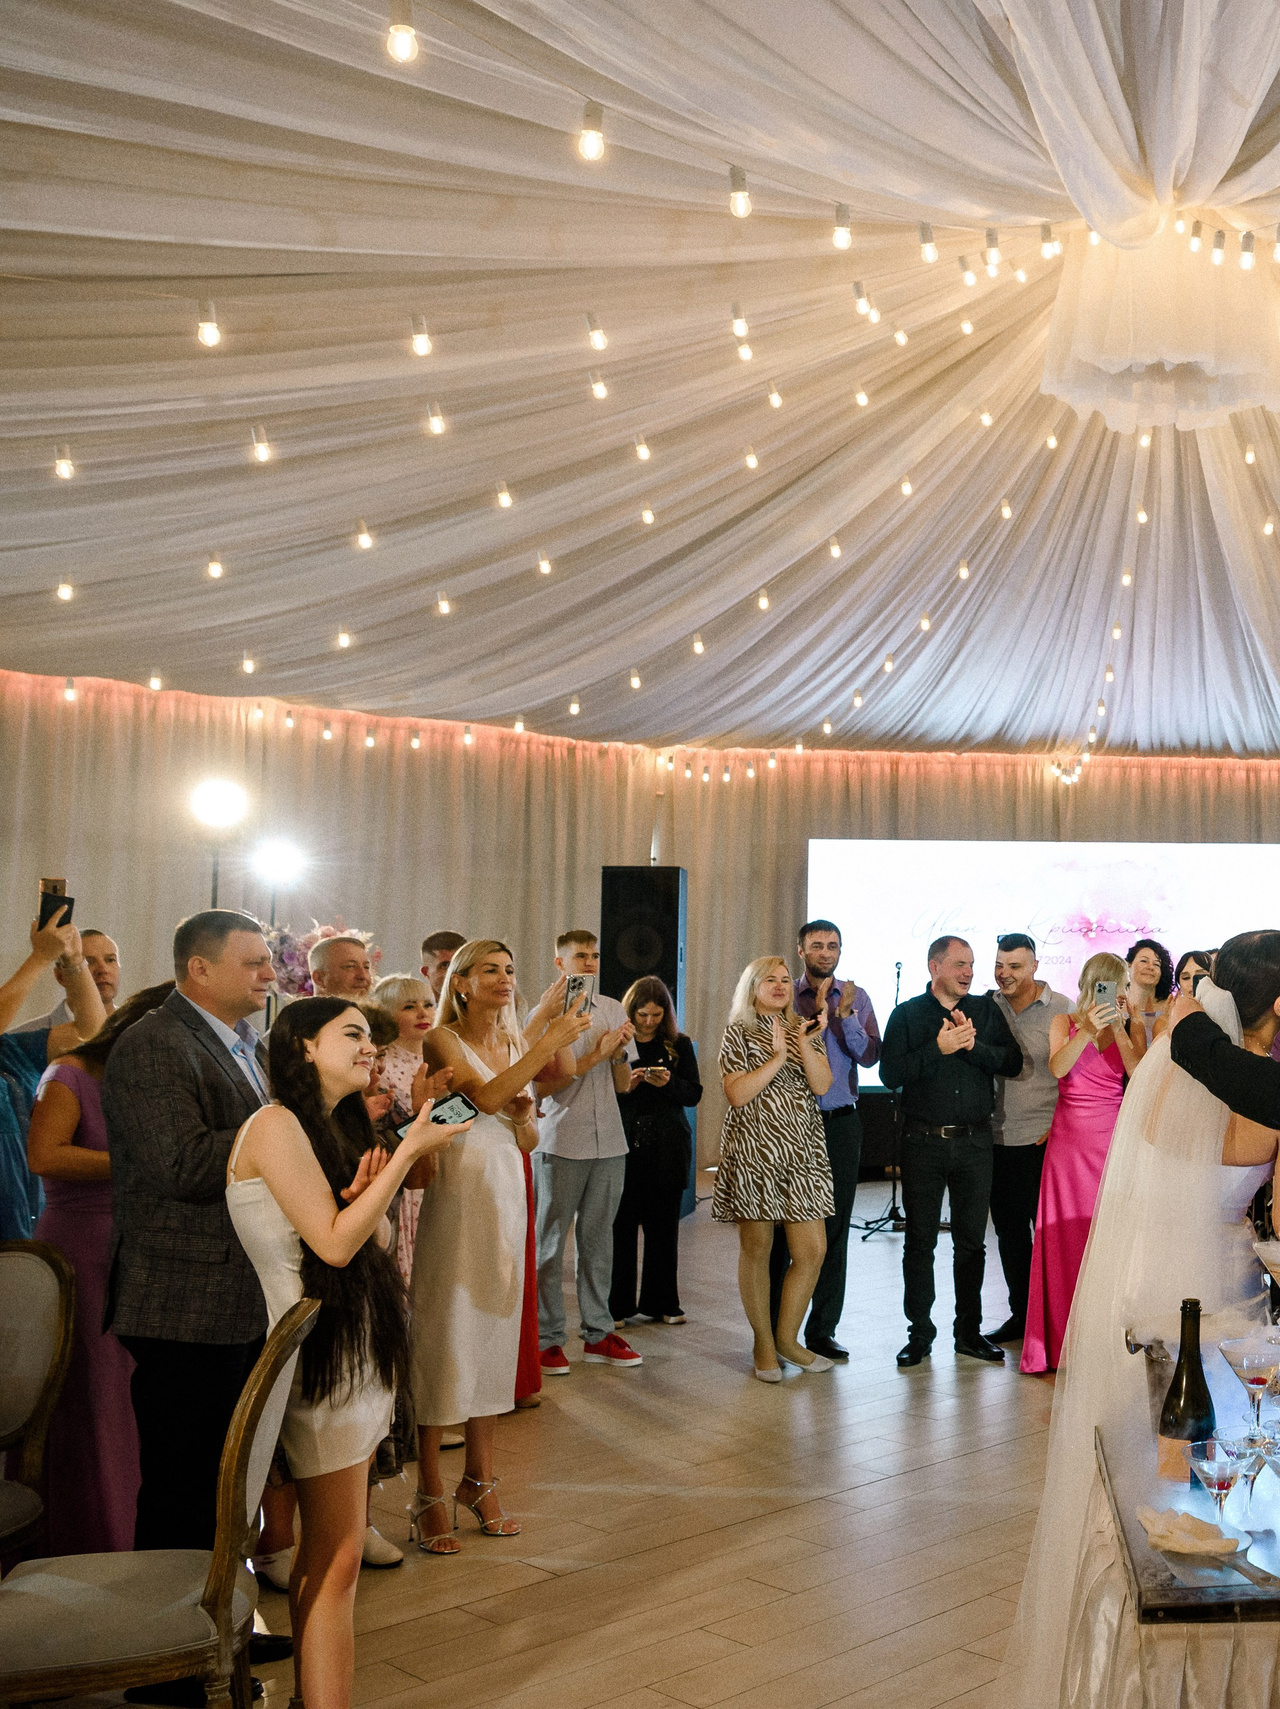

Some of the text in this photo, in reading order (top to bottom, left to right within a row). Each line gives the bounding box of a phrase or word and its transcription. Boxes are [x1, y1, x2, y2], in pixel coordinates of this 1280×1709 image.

[911, 906, 981, 947] Иван
[1026, 907, 1169, 949] Кристина
[1045, 955, 1072, 964] 2024
